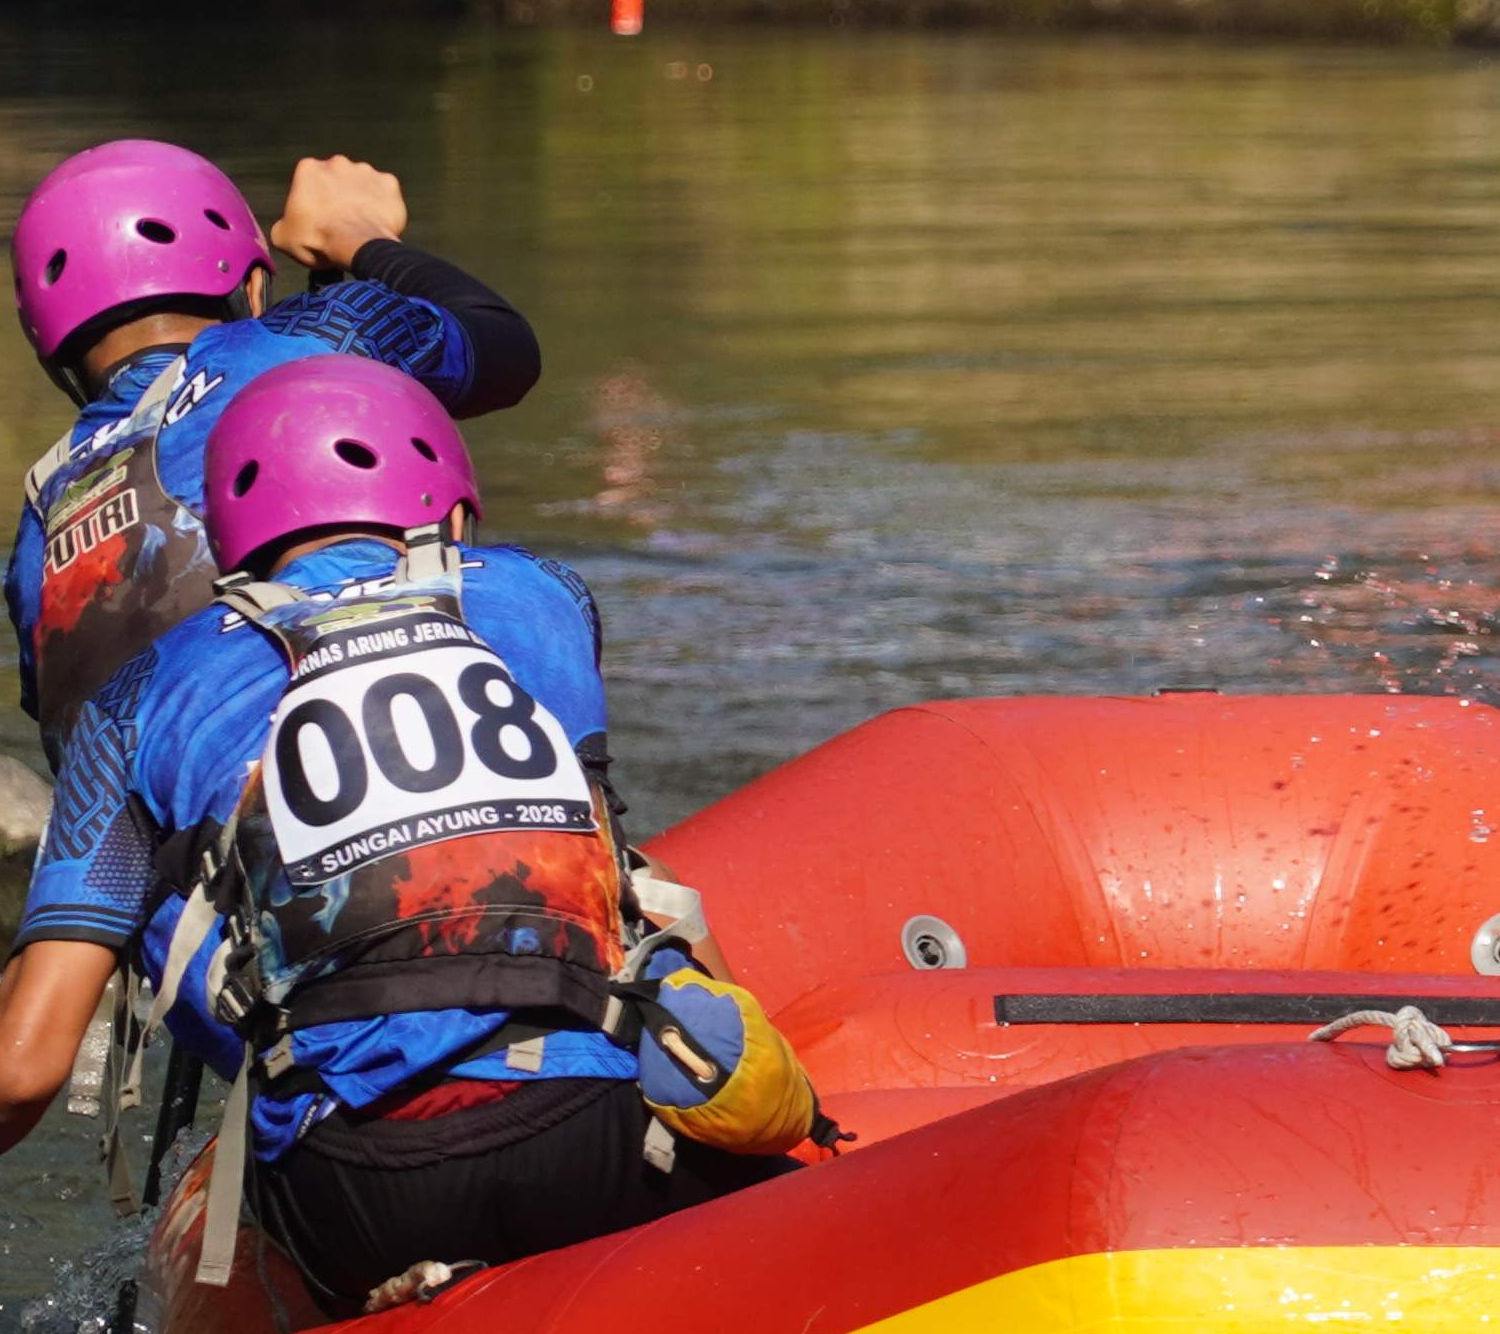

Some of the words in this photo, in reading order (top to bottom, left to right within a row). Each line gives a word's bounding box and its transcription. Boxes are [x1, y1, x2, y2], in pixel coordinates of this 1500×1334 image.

[347, 628, 408, 657] ARUNG
[276, 662, 558, 827] 008
[321, 824, 412, 872] SUNGAI
[416, 807, 499, 837] AYUNG
[516, 804, 566, 824] 2026
